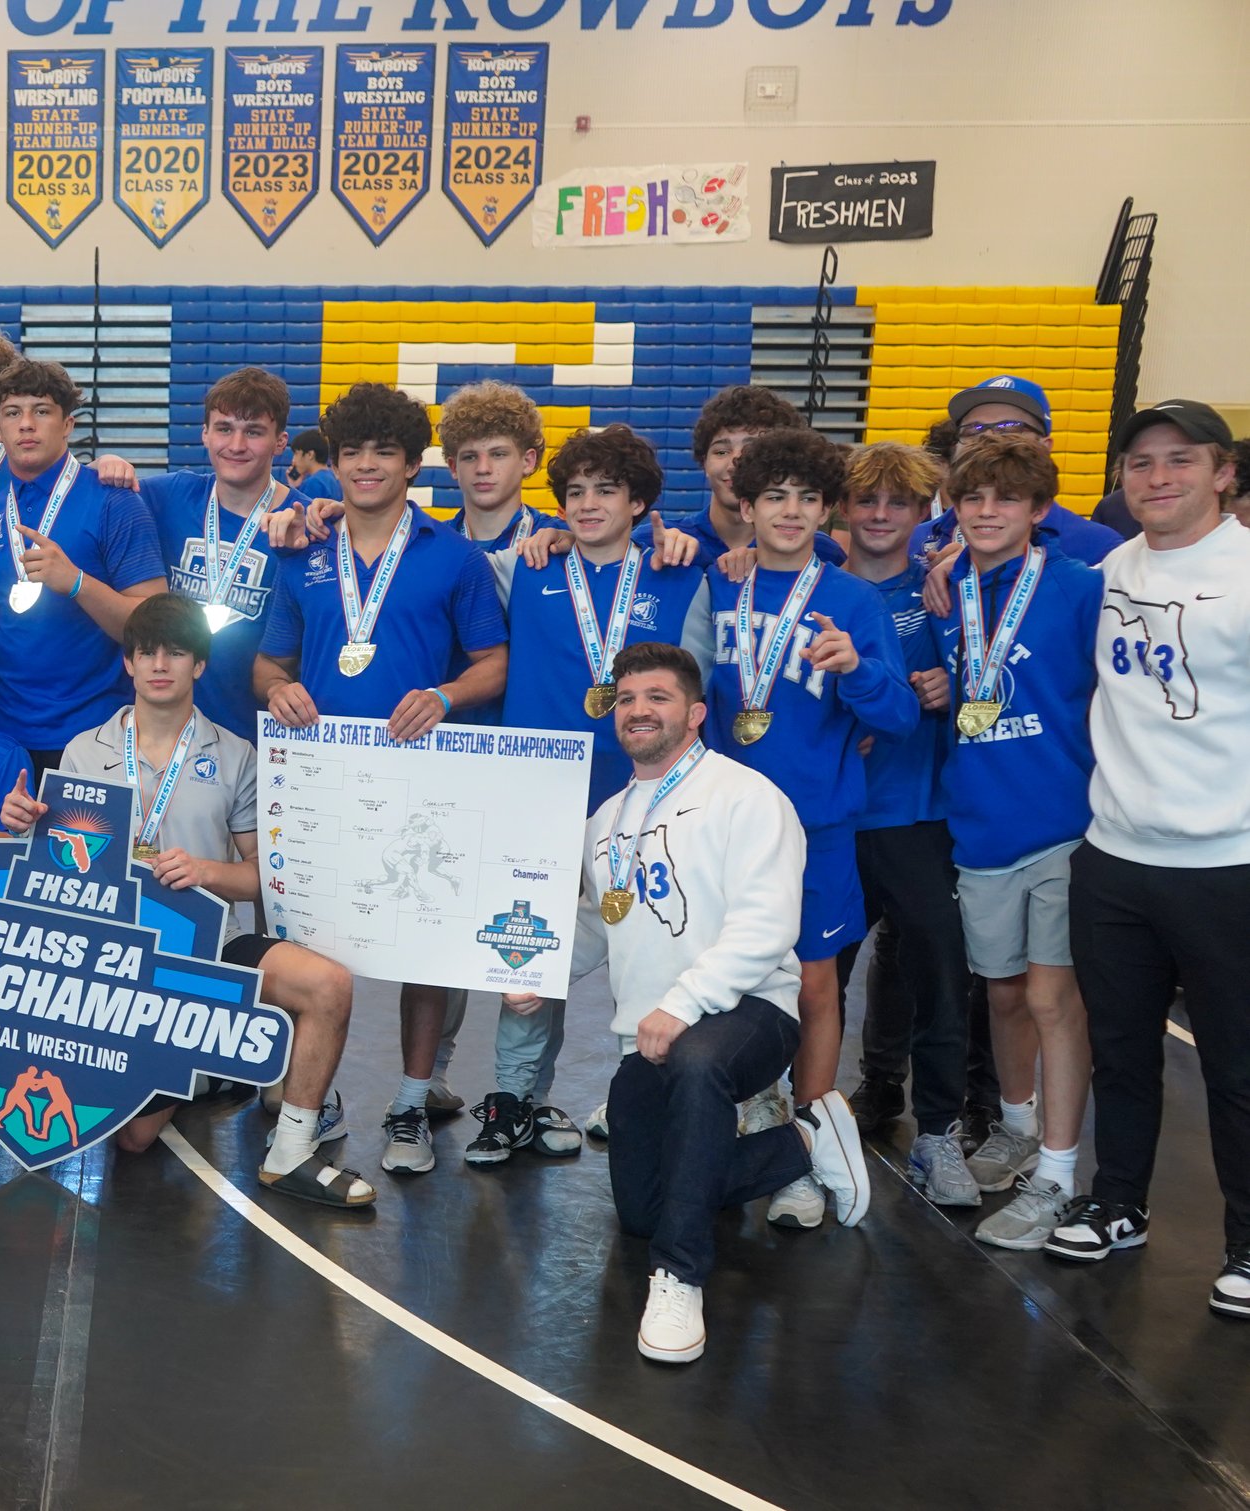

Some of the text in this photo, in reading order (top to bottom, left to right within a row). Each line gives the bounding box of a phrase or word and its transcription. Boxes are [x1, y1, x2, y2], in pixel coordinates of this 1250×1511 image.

[244, 62, 306, 75] KOWBOYS
[356, 60, 417, 73] KOWBOYS
[27, 70, 86, 85] KOWBOYS
[368, 77, 403, 90] BOYS
[256, 80, 292, 92] BOYS
[14, 90, 97, 106] WRESTLING
[233, 94, 314, 106] WRESTLING
[344, 91, 425, 104] WRESTLING
[32, 109, 79, 121] STATE
[251, 110, 295, 121] STATE
[362, 107, 406, 119] STATE
[14, 123, 97, 135] RUNNER-UP
[234, 124, 311, 135] RUNNER-UP
[344, 121, 422, 133] RUNNER-UP
[14, 136, 97, 149] TEAM DUALS
[229, 137, 316, 150] TEAM DUALS
[339, 135, 427, 147] TEAM DUALS
[18, 154, 91, 179] 2020
[233, 154, 309, 178] 2023
[344, 152, 420, 176] 2024
[232, 180, 308, 192] CLASS 3A
[342, 178, 418, 190] CLASS 3A
[835, 172, 918, 186] Class of 2028
[18, 183, 90, 195] CLASS 3A
[557, 180, 669, 237] FRESH
[779, 171, 906, 234] FRESHMEN
[229, 521, 256, 570] WRESTLING
[340, 531, 351, 579] WRESTLING
[372, 551, 398, 604] WRESTLING
[618, 560, 636, 615] WRESTLING
[1006, 569, 1036, 629] WRESTLING
[764, 616, 791, 676] WRESTLING
[1112, 637, 1175, 682] 813
[958, 713, 1043, 745] GERS
[263, 717, 286, 739] 2025
[323, 723, 336, 744] 2A
[340, 724, 371, 746] STATE
[436, 730, 495, 755] WRESTLING
[498, 735, 586, 761] CHAMPIONSHIPS
[126, 726, 135, 777] WRESTLING
[62, 783, 107, 805] 2025
[155, 762, 180, 815] WRESTLING
[513, 868, 549, 881] Champion
[635, 862, 670, 904] 13
[23, 870, 120, 914] FHSAA
[505, 925, 534, 936] STATE
[478, 931, 559, 949] CHAMPIONSHIPS
[95, 943, 143, 982] 2A
[26, 1033, 129, 1073] WRESTLING
